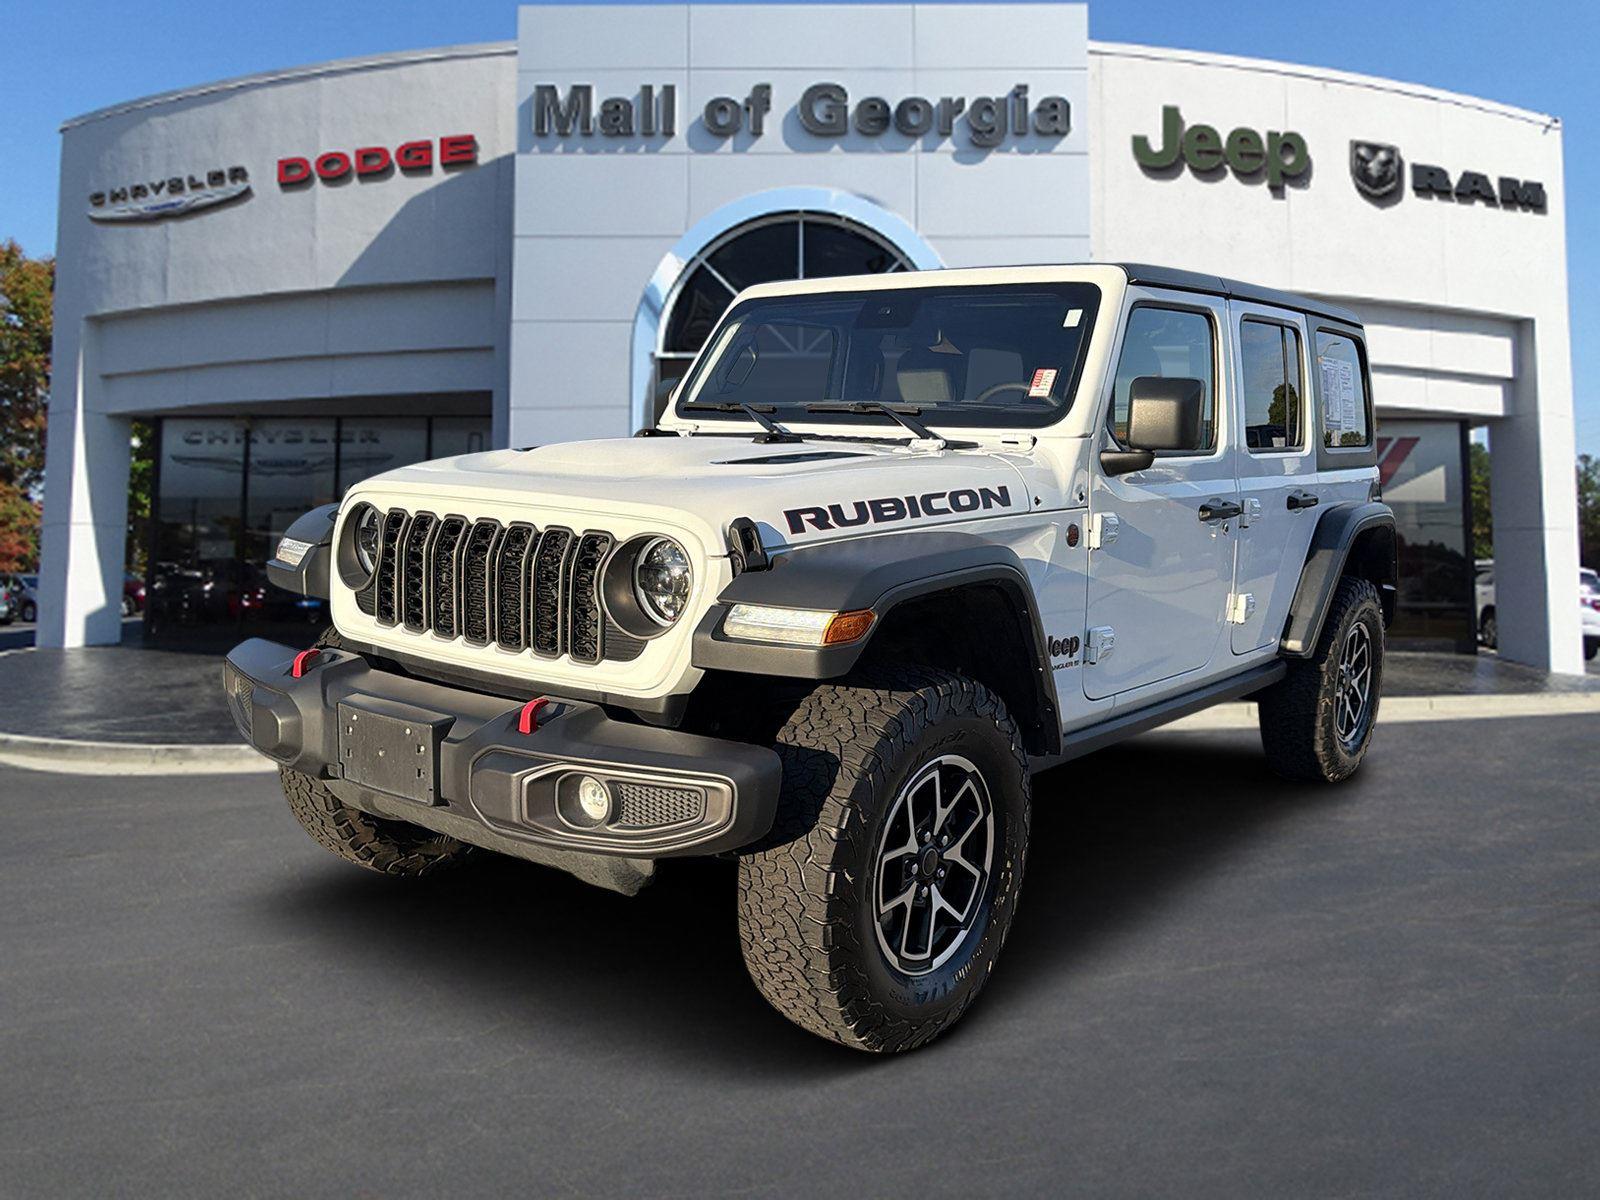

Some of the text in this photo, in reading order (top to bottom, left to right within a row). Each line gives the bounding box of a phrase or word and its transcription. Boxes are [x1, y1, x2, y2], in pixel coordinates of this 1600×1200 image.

[532, 82, 1072, 148] Mall of Georgia
[277, 134, 477, 187] DODGE
[1131, 105, 1310, 192] Jeep
[89, 165, 249, 207] CHRYSLER
[1411, 162, 1548, 213] RAM
[783, 485, 1012, 535] RUBICON
